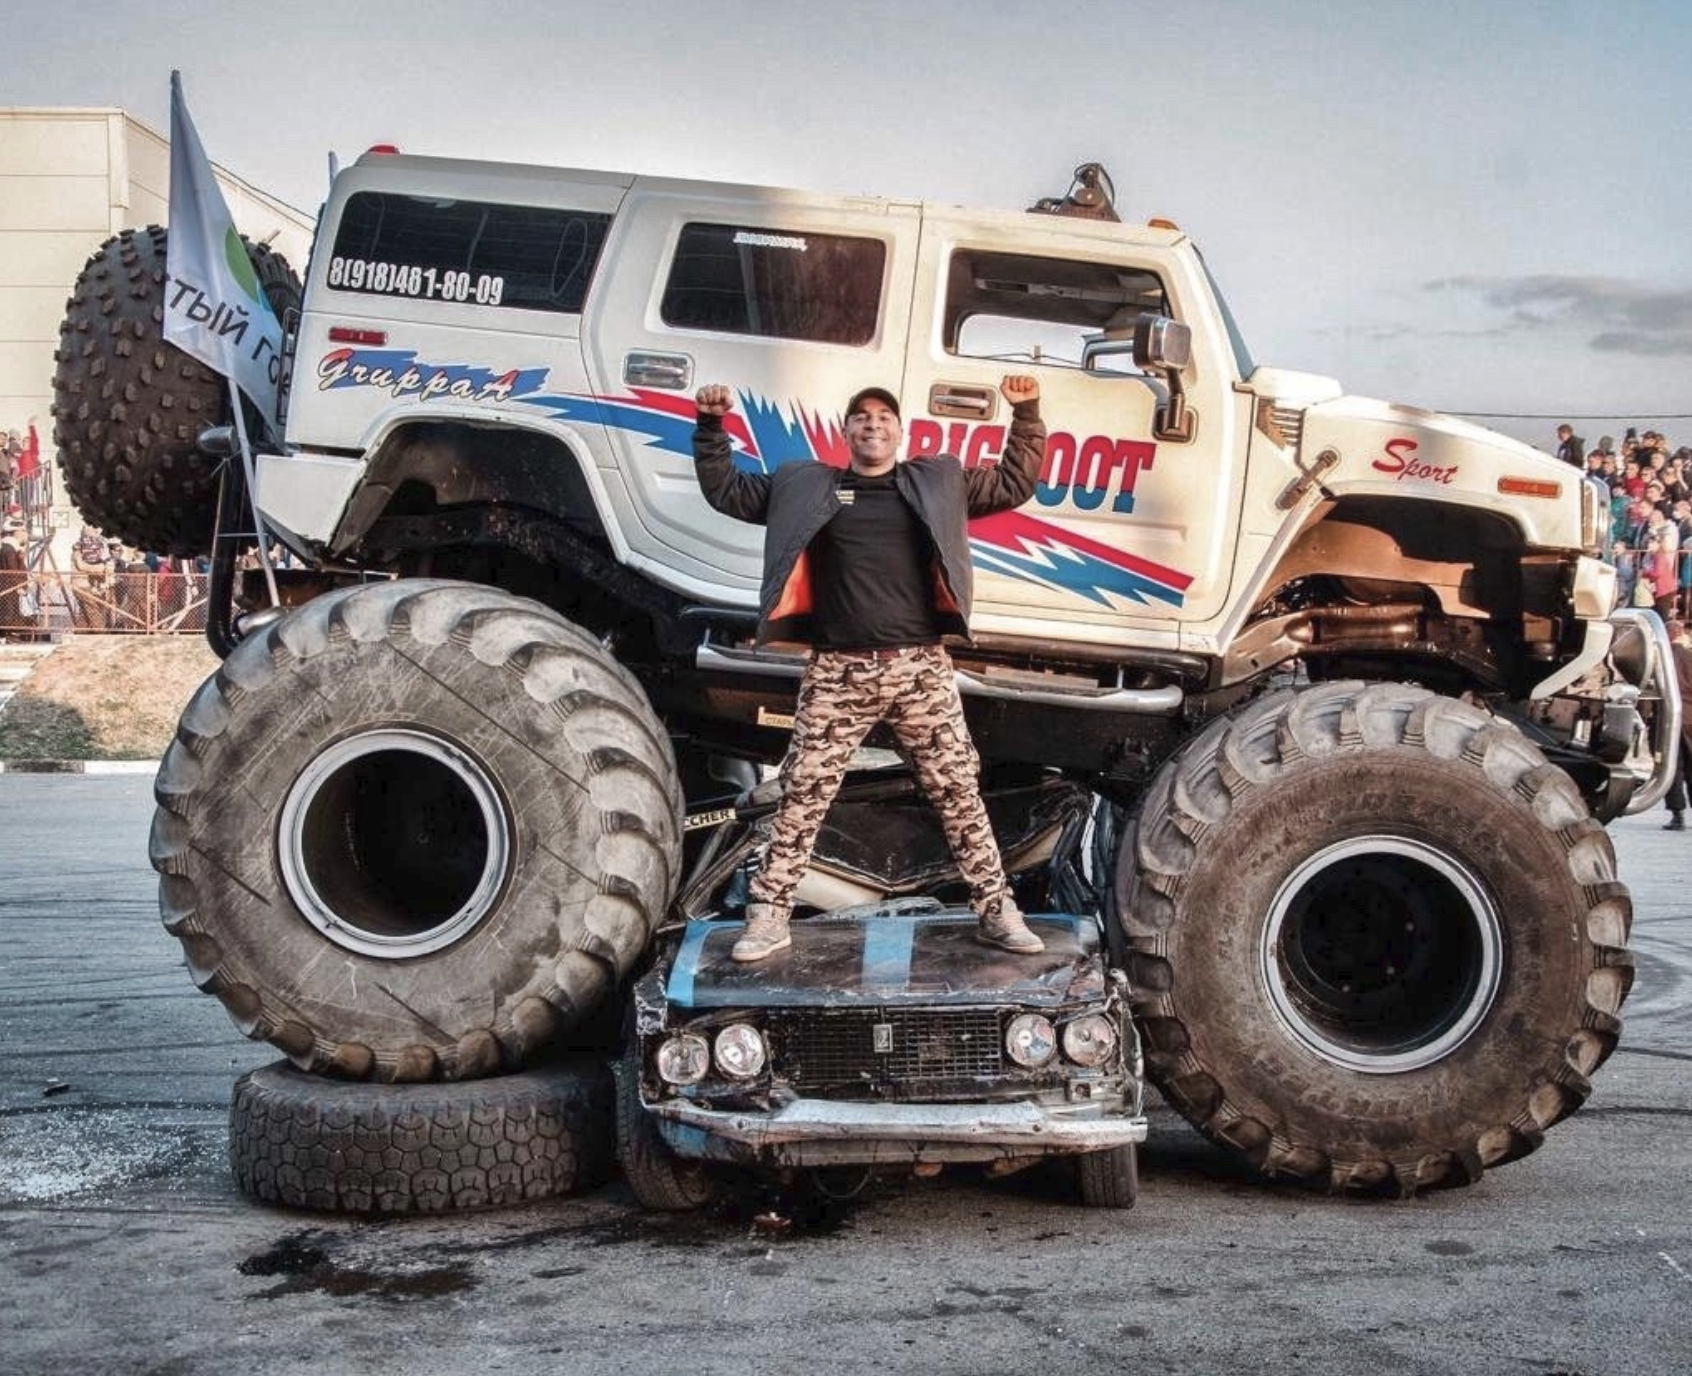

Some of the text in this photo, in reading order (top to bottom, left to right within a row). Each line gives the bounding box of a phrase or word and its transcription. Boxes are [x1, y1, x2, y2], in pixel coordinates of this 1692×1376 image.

[165, 274, 249, 346] ТЫЙ
[905, 418, 1157, 514] BIGOOT
[1371, 438, 1458, 484] Sport
